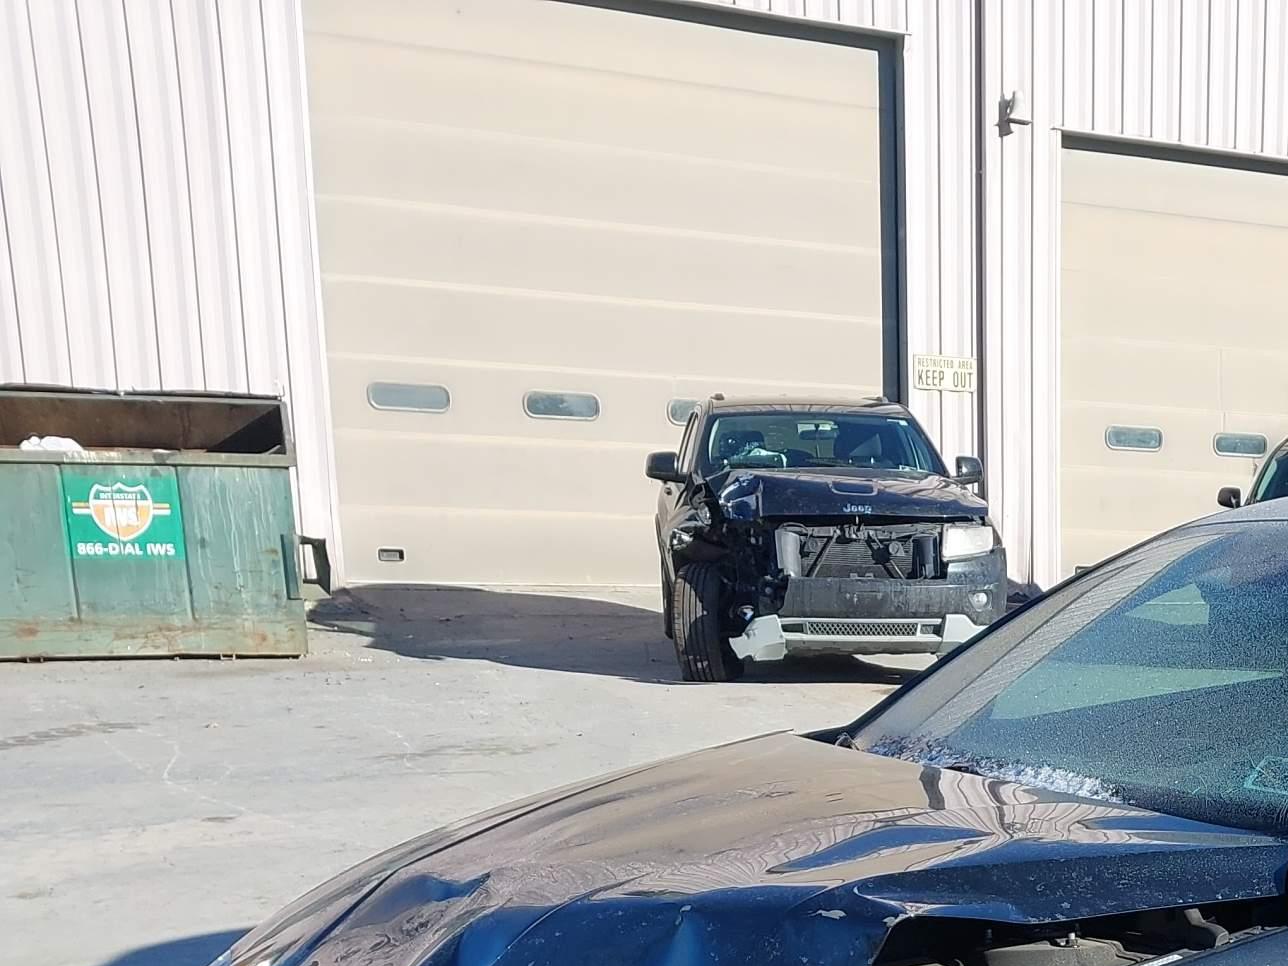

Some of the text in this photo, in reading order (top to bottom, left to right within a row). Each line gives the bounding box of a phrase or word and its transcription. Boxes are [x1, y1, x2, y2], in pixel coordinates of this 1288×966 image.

[918, 357, 973, 370] RESTRICTED AREA
[917, 369, 974, 389] KEEP OUT
[842, 503, 873, 514] Jeep
[76, 542, 175, 556] 866-DIAL IWS
